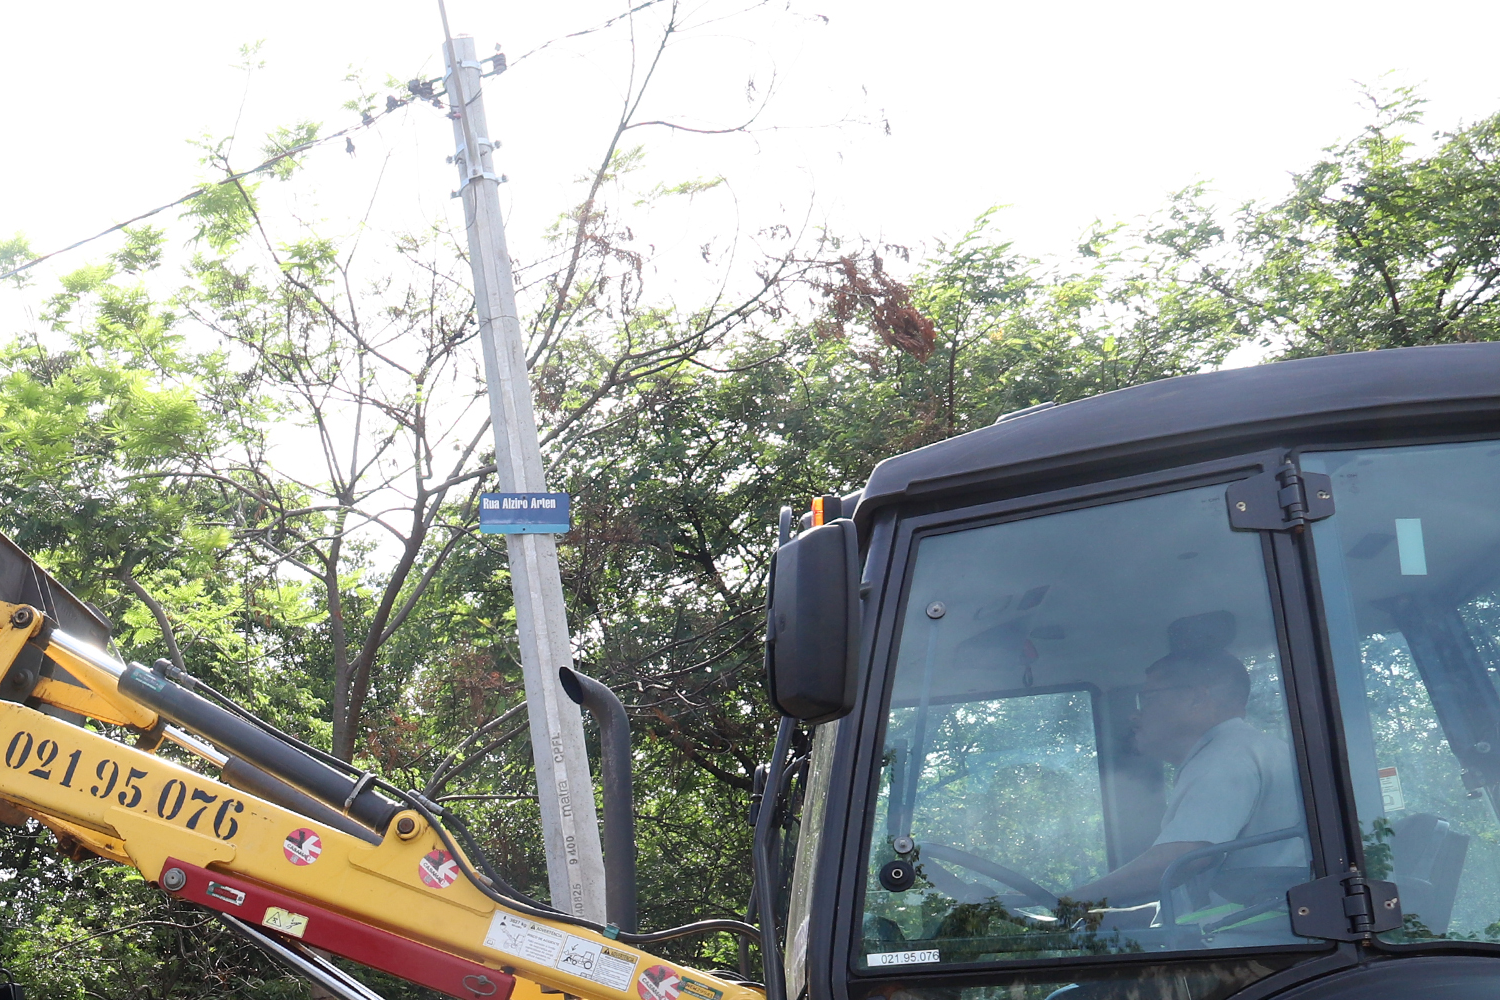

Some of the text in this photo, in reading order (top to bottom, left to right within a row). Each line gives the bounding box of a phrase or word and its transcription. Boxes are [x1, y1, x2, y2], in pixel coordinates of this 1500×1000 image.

[483, 498, 556, 509] Rua Alziro Arten
[551, 732, 564, 763] CPFL
[4, 730, 244, 840] 021.95.076
[558, 780, 572, 817] matra
[881, 951, 939, 964] 021.95.076
